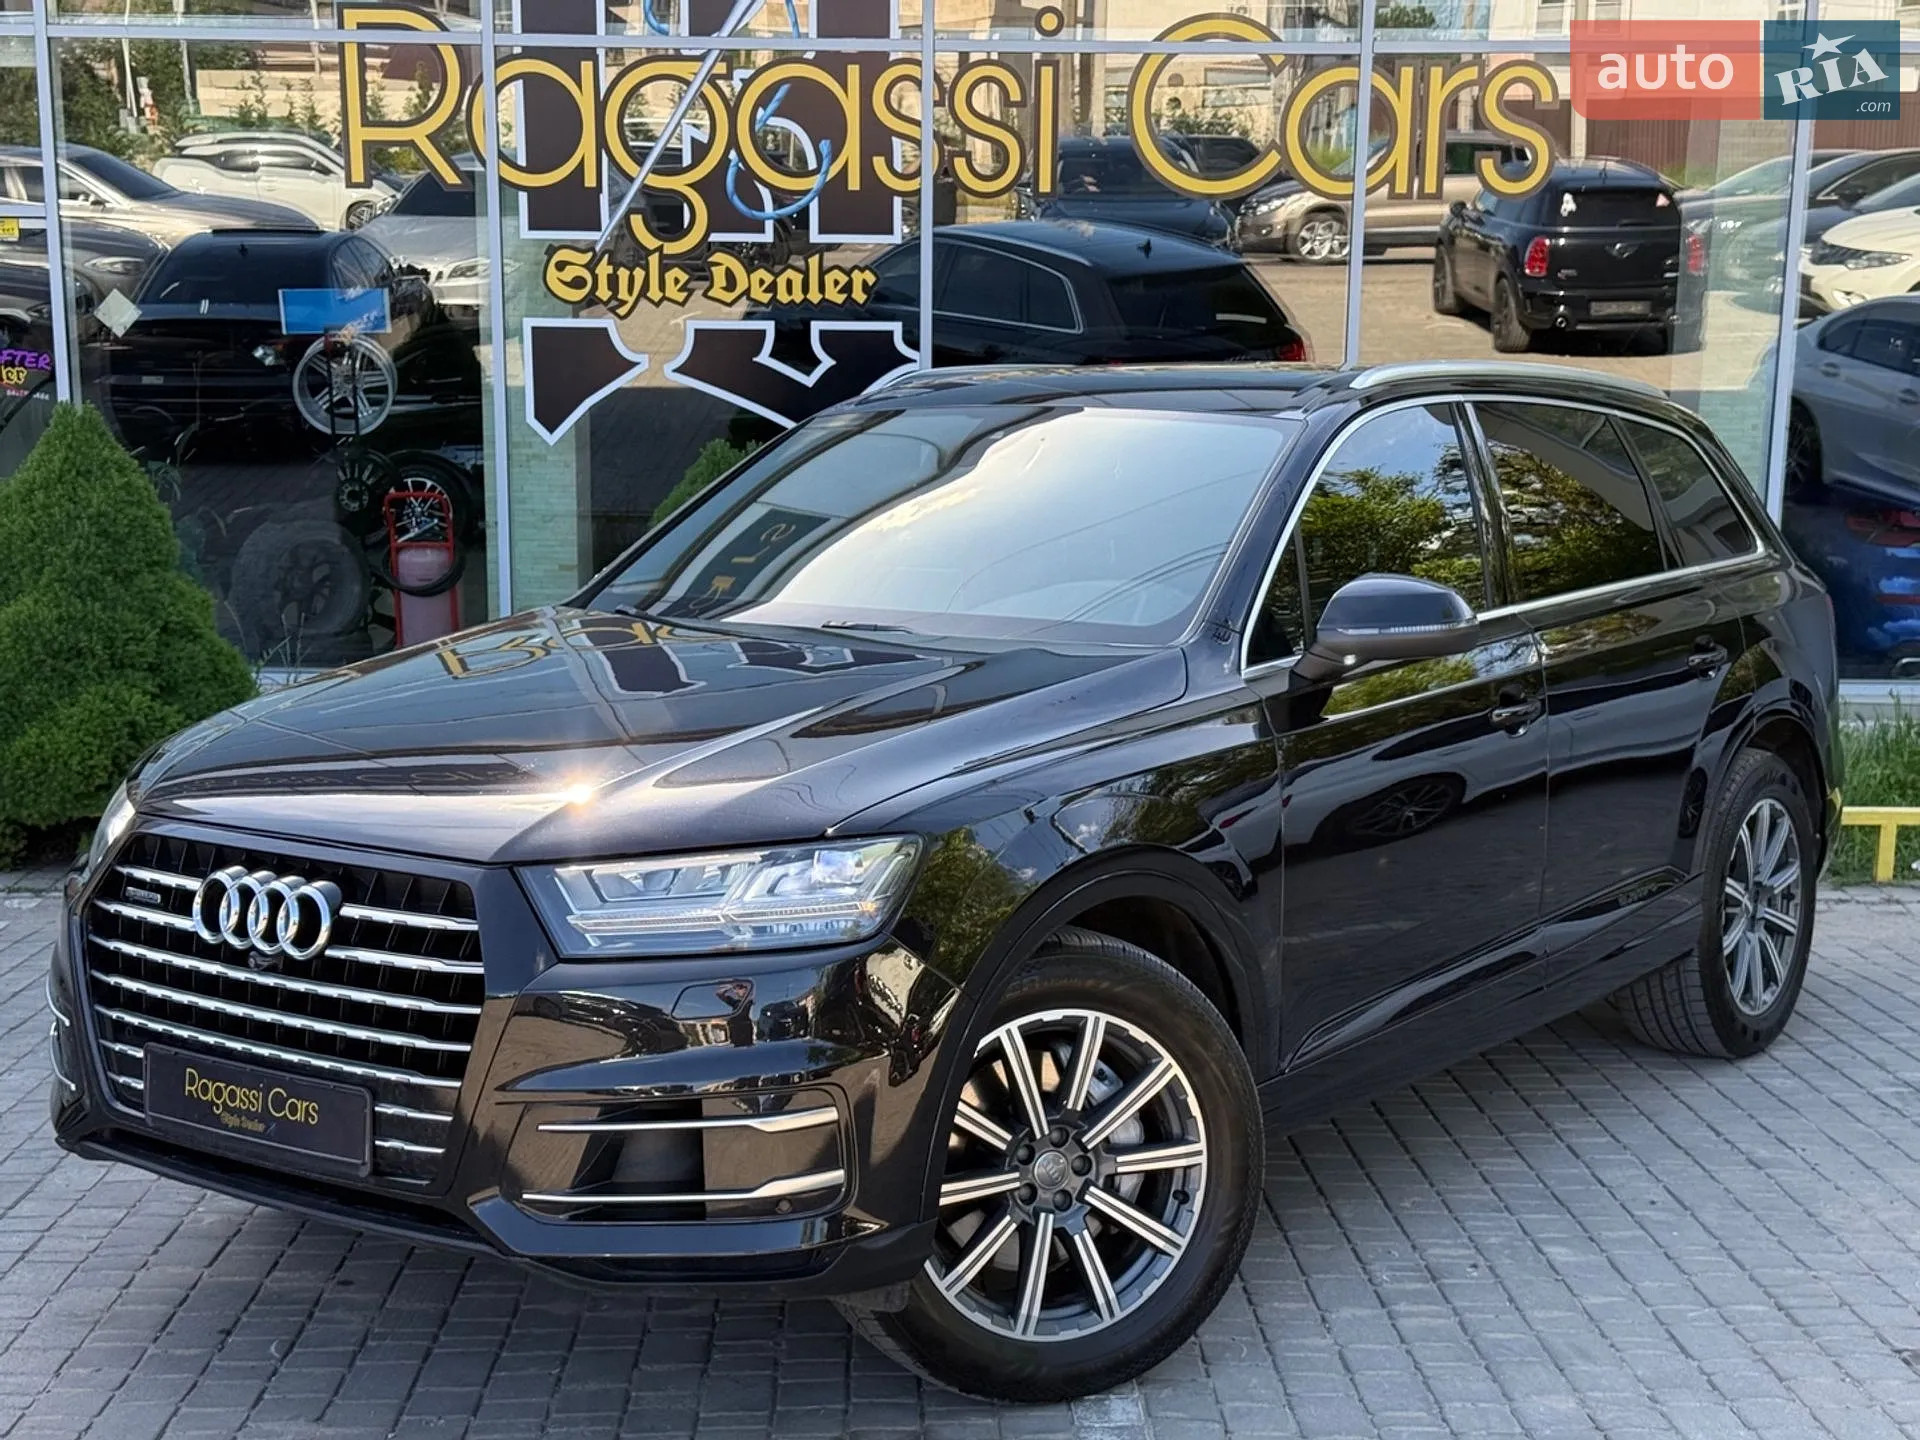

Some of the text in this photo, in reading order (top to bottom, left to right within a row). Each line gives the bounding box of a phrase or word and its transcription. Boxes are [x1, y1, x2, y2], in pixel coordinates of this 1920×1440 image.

[339, 4, 1559, 255] Ragassi Cars
[543, 245, 878, 319] Style Dealer
[184, 1067, 263, 1115] Ragassi
[268, 1087, 319, 1125] Cars
